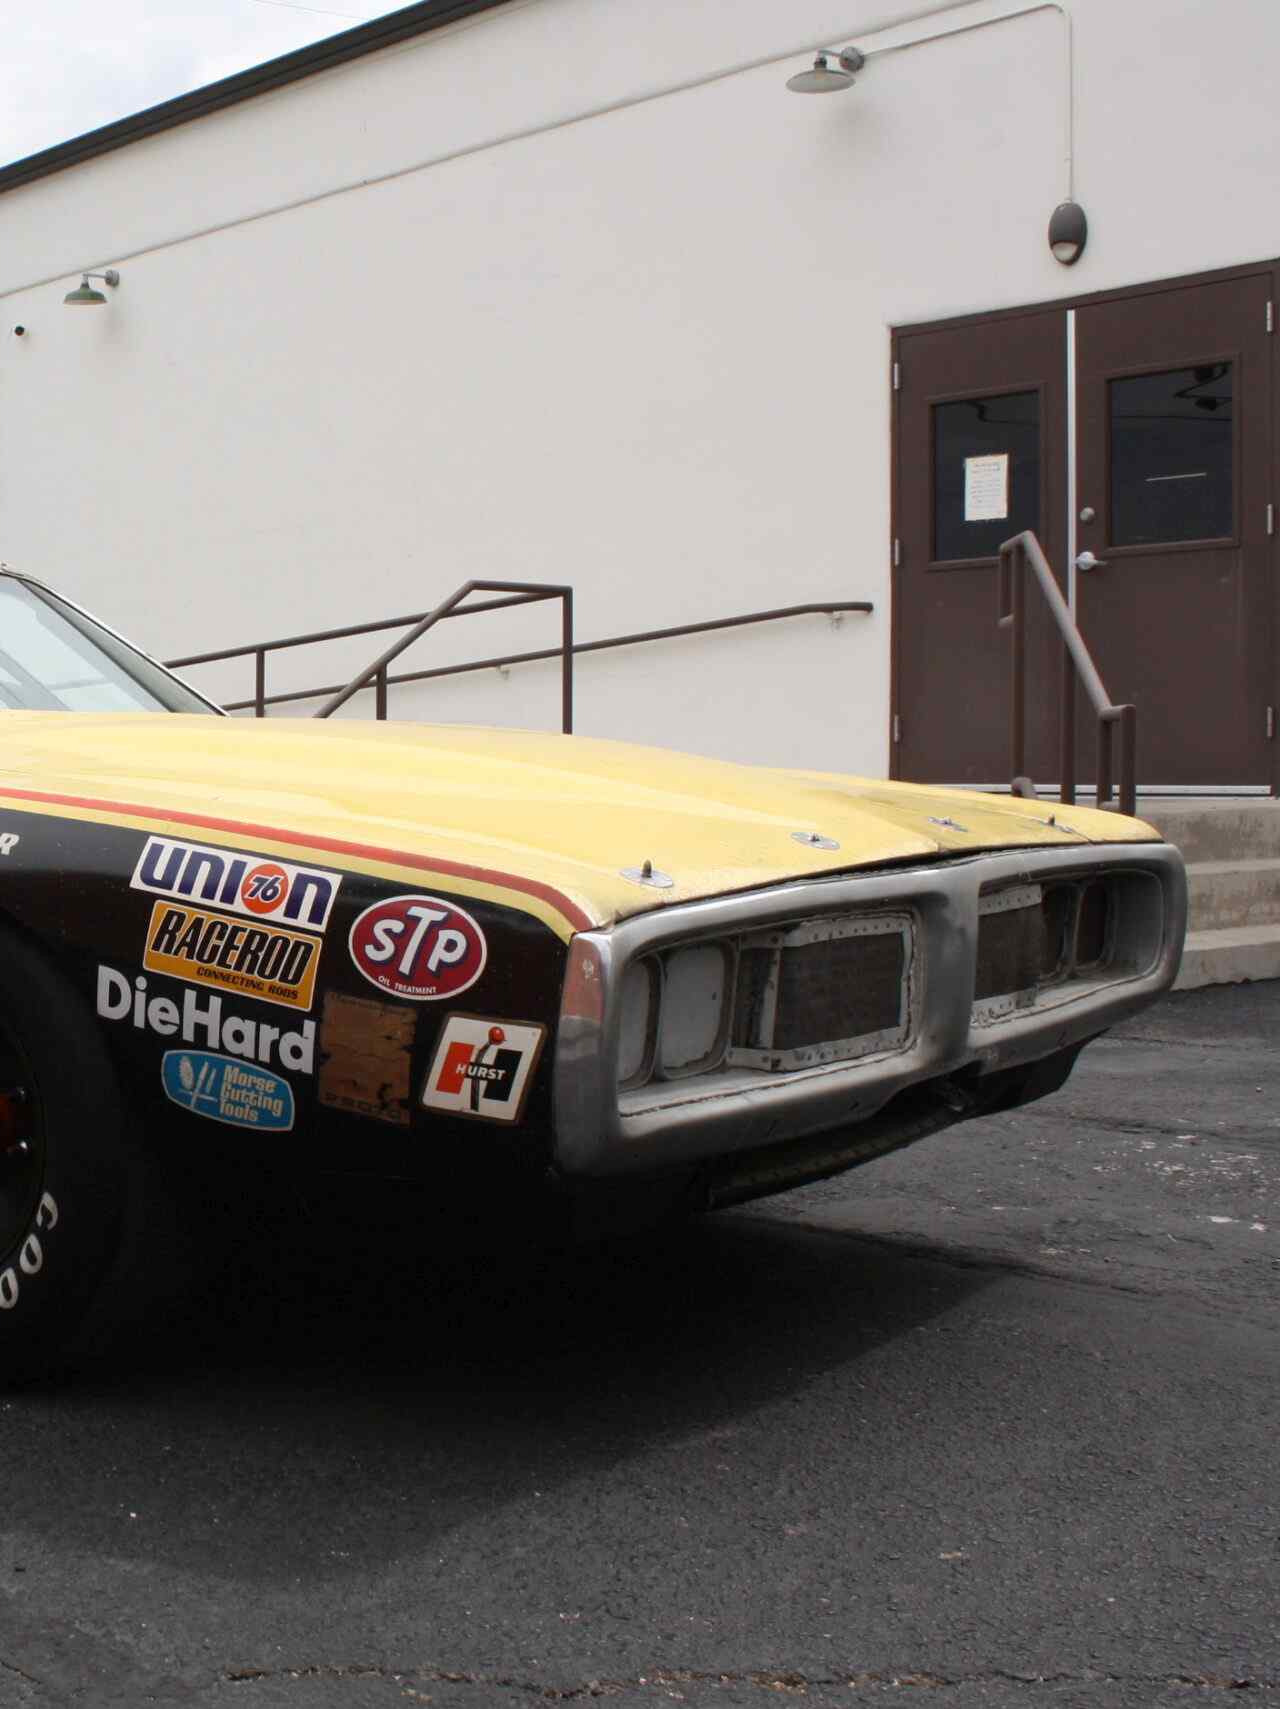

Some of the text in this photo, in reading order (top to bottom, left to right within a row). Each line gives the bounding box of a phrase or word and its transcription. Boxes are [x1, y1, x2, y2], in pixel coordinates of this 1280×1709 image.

[243, 874, 282, 903] 76
[151, 909, 314, 986] RACEROD
[364, 905, 468, 976] STP
[196, 966, 299, 1000] CONNECTING RODS
[378, 975, 391, 986] OIL
[97, 964, 316, 1074] DieHard
[223, 1065, 276, 1093] Morse
[455, 1063, 506, 1081] HURST
[220, 1100, 259, 1122] Tools
